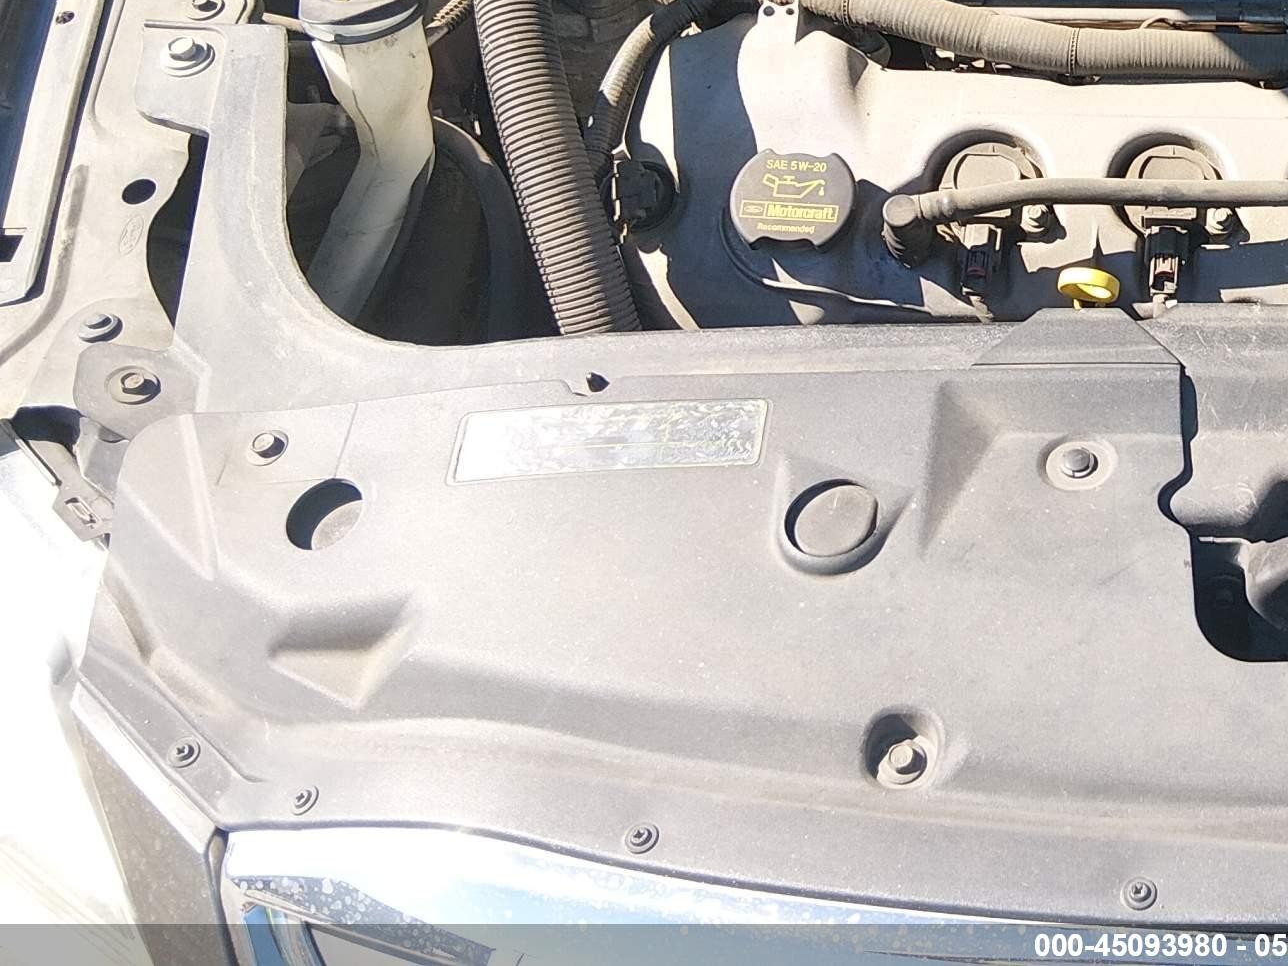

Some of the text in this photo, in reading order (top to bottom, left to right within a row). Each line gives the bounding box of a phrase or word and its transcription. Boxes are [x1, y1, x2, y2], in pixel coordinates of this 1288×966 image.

[766, 159, 828, 173] SAE 5W-20
[767, 204, 834, 220] Motorcraft
[757, 222, 817, 235] Recommended
